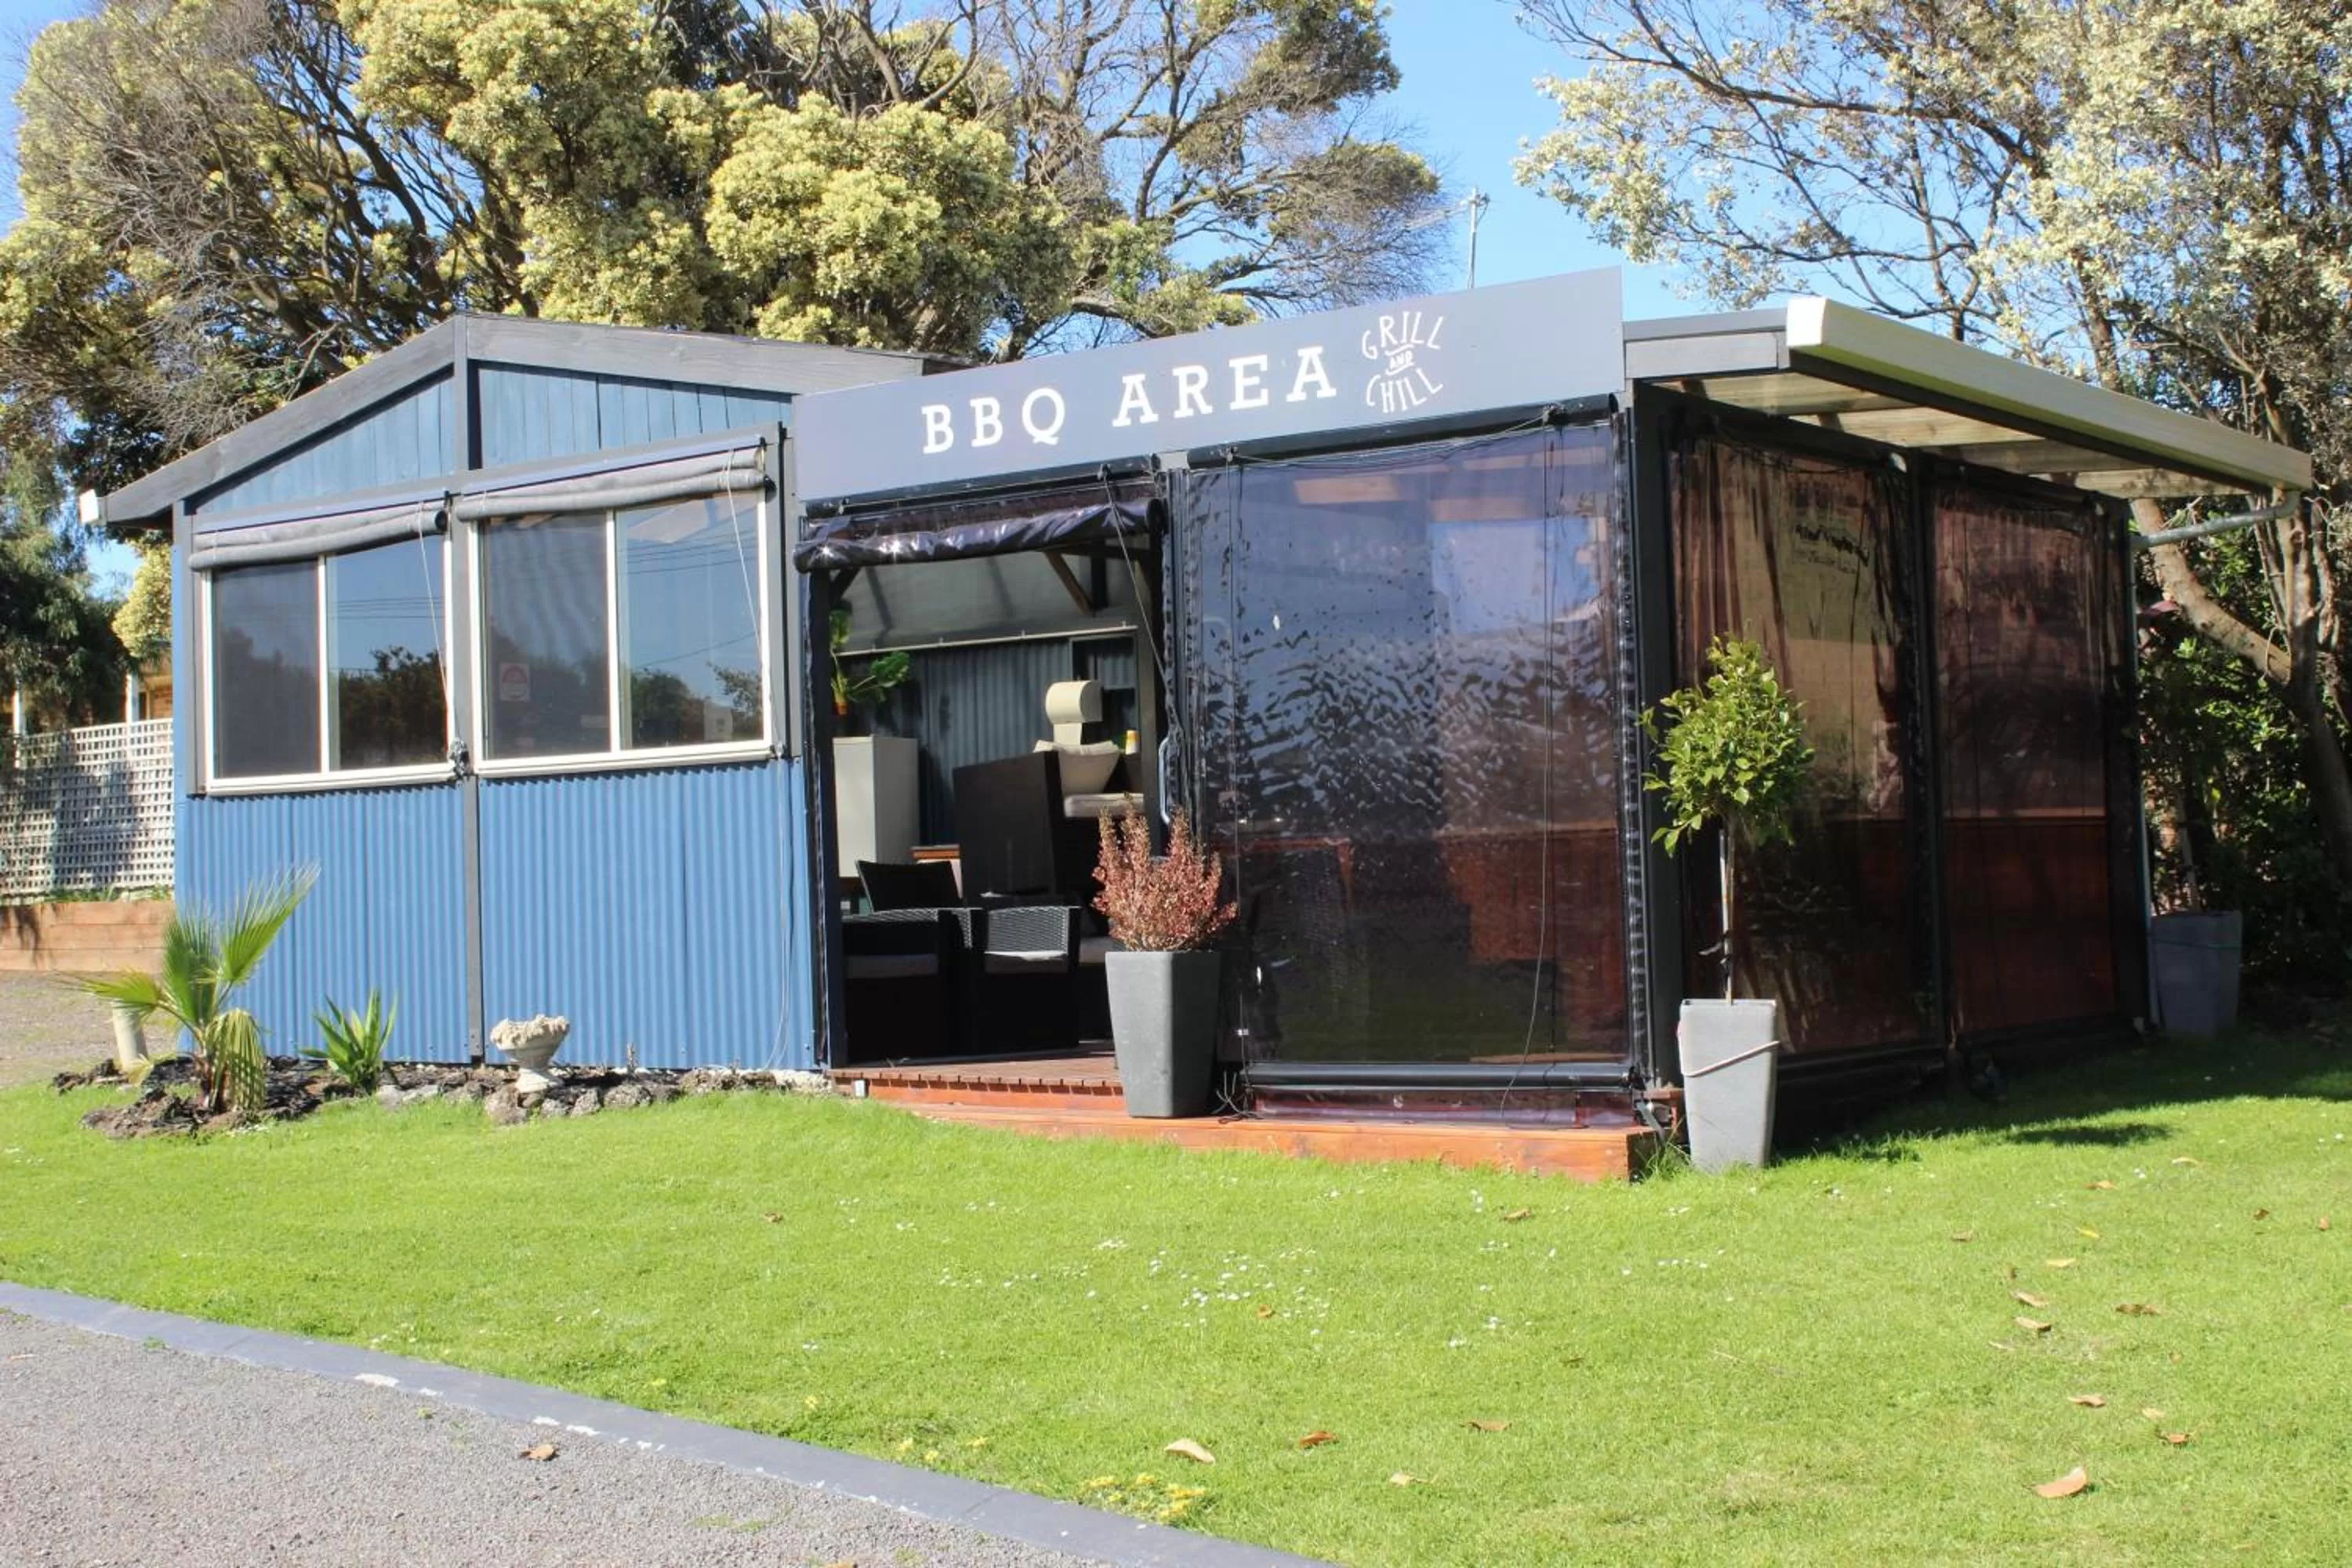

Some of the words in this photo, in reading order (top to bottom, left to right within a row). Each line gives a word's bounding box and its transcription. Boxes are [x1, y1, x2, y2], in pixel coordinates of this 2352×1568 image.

[1362, 311, 1444, 360] GRILL
[1389, 350, 1413, 369] AND
[922, 387, 1065, 454] BBQ
[1112, 347, 1337, 427] AREA
[1367, 368, 1443, 412] CHILL
